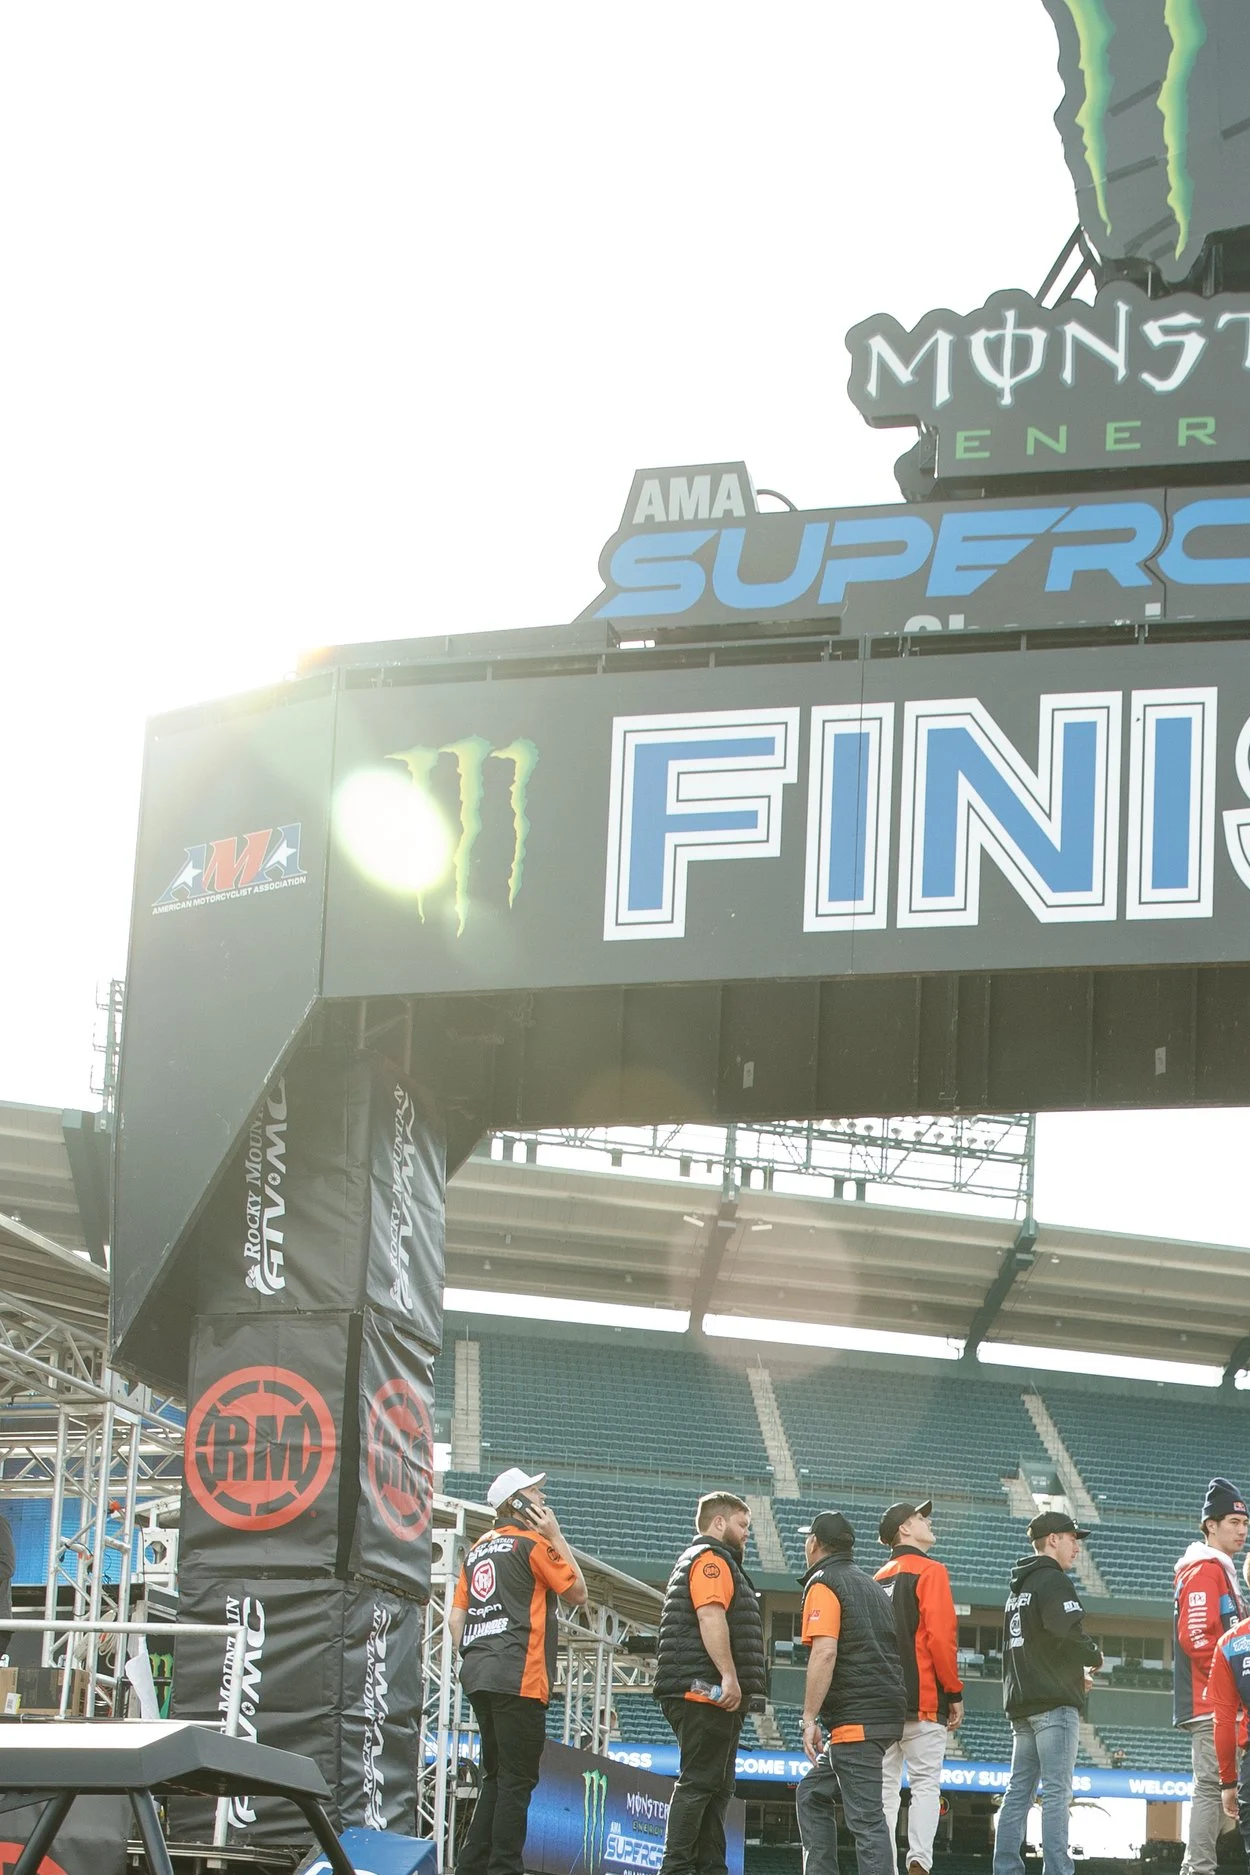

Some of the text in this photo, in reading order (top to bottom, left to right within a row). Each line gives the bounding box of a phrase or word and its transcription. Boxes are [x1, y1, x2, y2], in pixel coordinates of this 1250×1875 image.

[631, 473, 746, 525] AMA
[152, 822, 308, 907] AMA
[152, 876, 307, 915] AMERICAN MOTORCYCLIST ASSOCIATION
[244, 1190, 261, 1261] ROCKY
[213, 1415, 303, 1482] RM
[735, 1758, 785, 1775] COME
